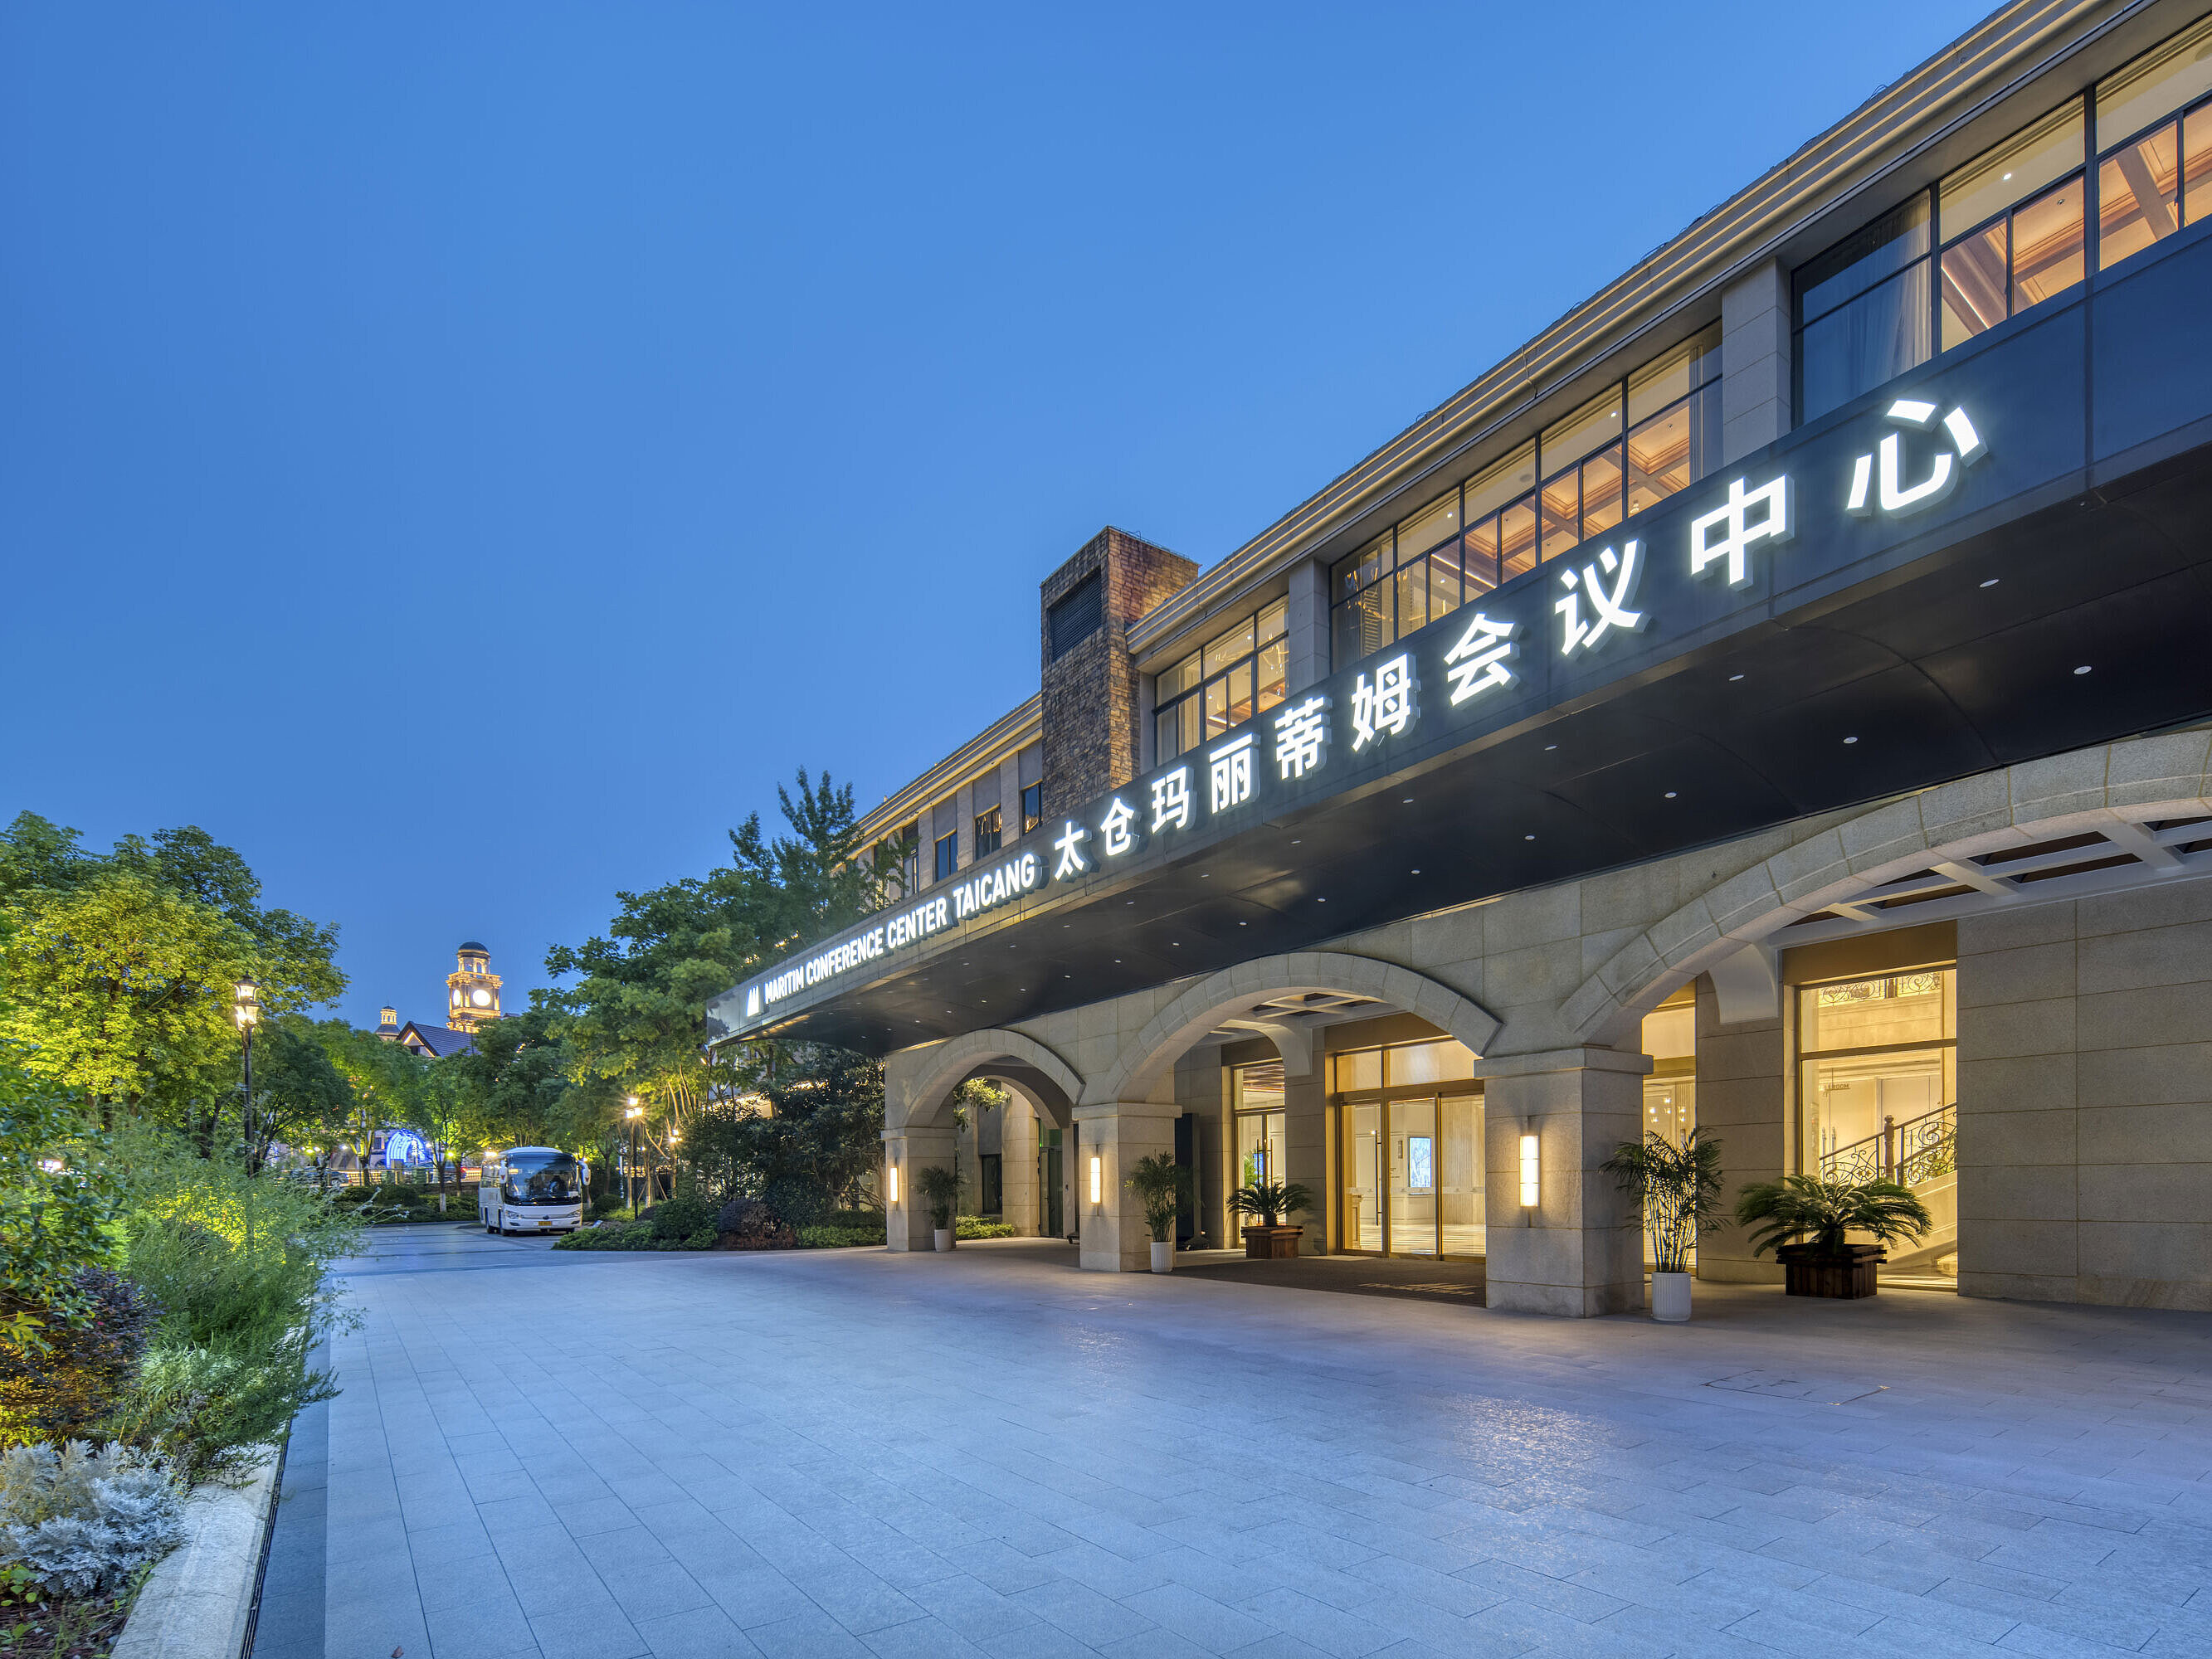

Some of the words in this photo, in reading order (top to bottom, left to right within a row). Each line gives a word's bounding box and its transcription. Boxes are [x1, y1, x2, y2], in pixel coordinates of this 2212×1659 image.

[1054, 400, 1981, 881] 太仓玛丽蒂姆会议中心
[764, 966, 804, 1005] MARITIM
[806, 927, 884, 985] CONFERENCE
[887, 897, 948, 950] CENTER
[953, 854, 1035, 918] TAICANG
